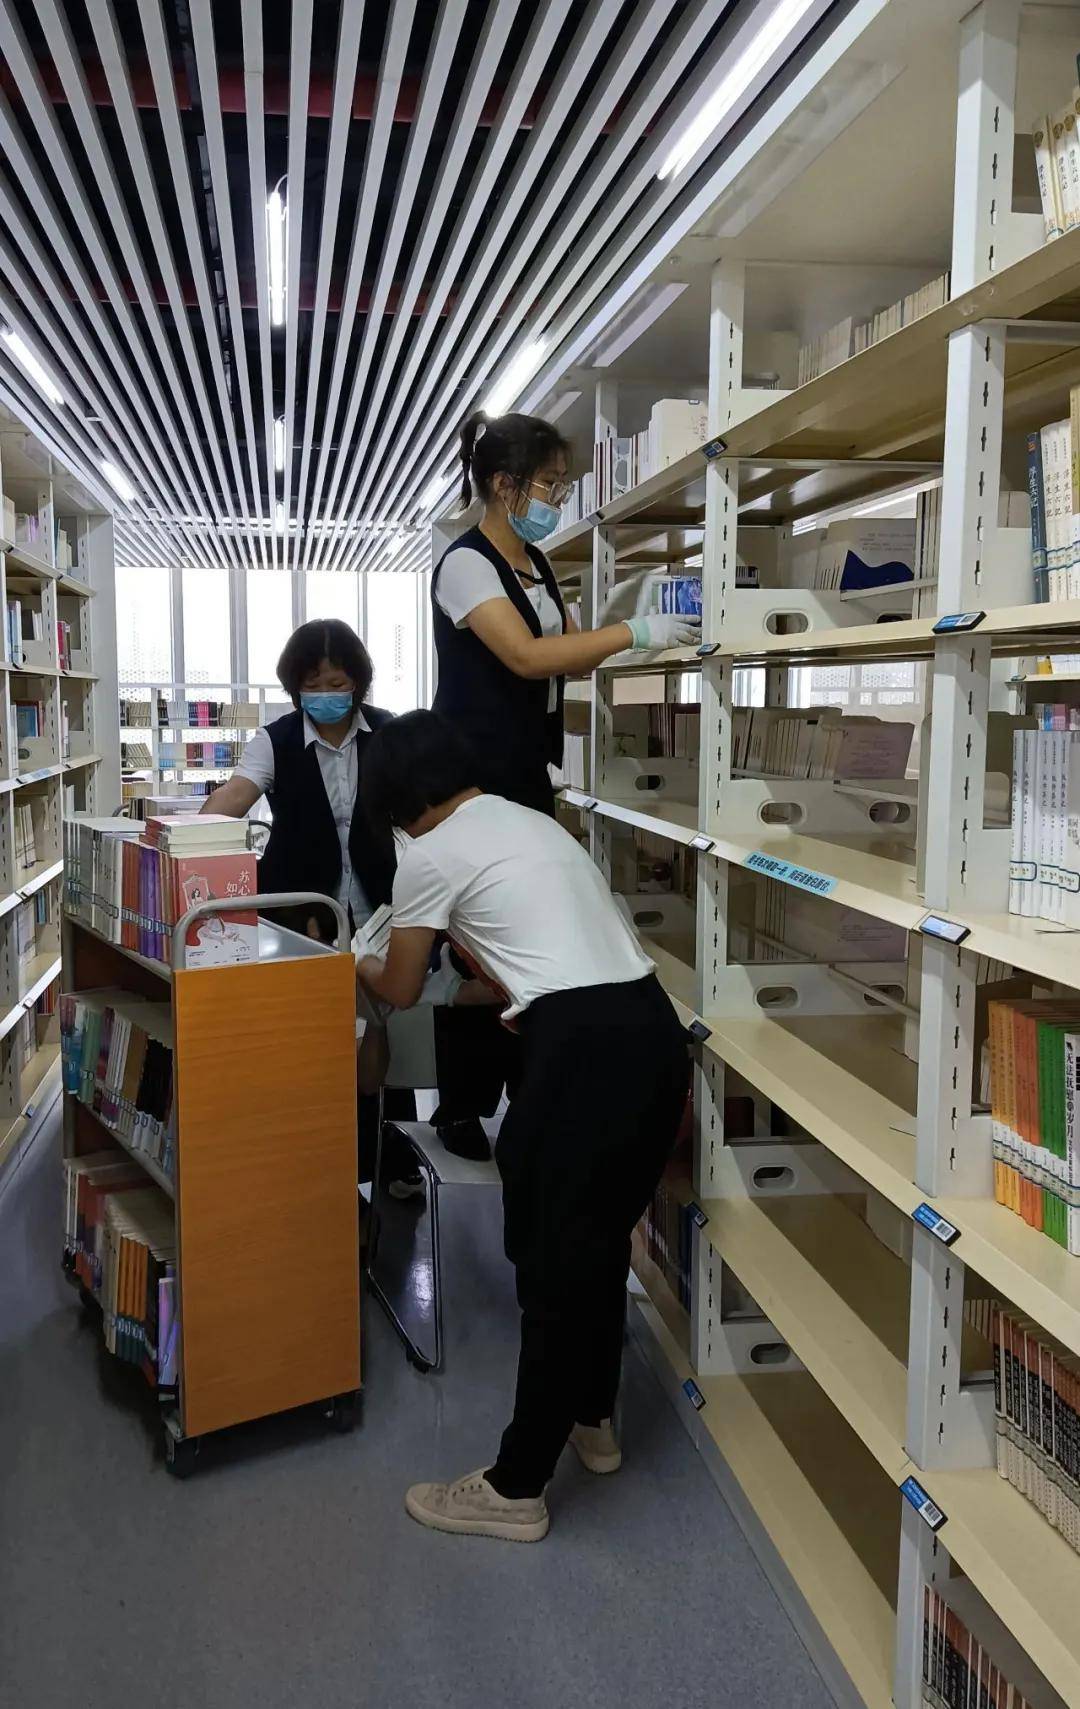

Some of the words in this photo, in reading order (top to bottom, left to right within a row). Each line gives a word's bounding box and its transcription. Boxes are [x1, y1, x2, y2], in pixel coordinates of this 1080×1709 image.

[1029, 466, 1039, 508] 浮生六记
[1045, 474, 1054, 518] 浮生六记
[1054, 471, 1062, 516] 浮生六记
[1063, 468, 1072, 513] 浮生六记
